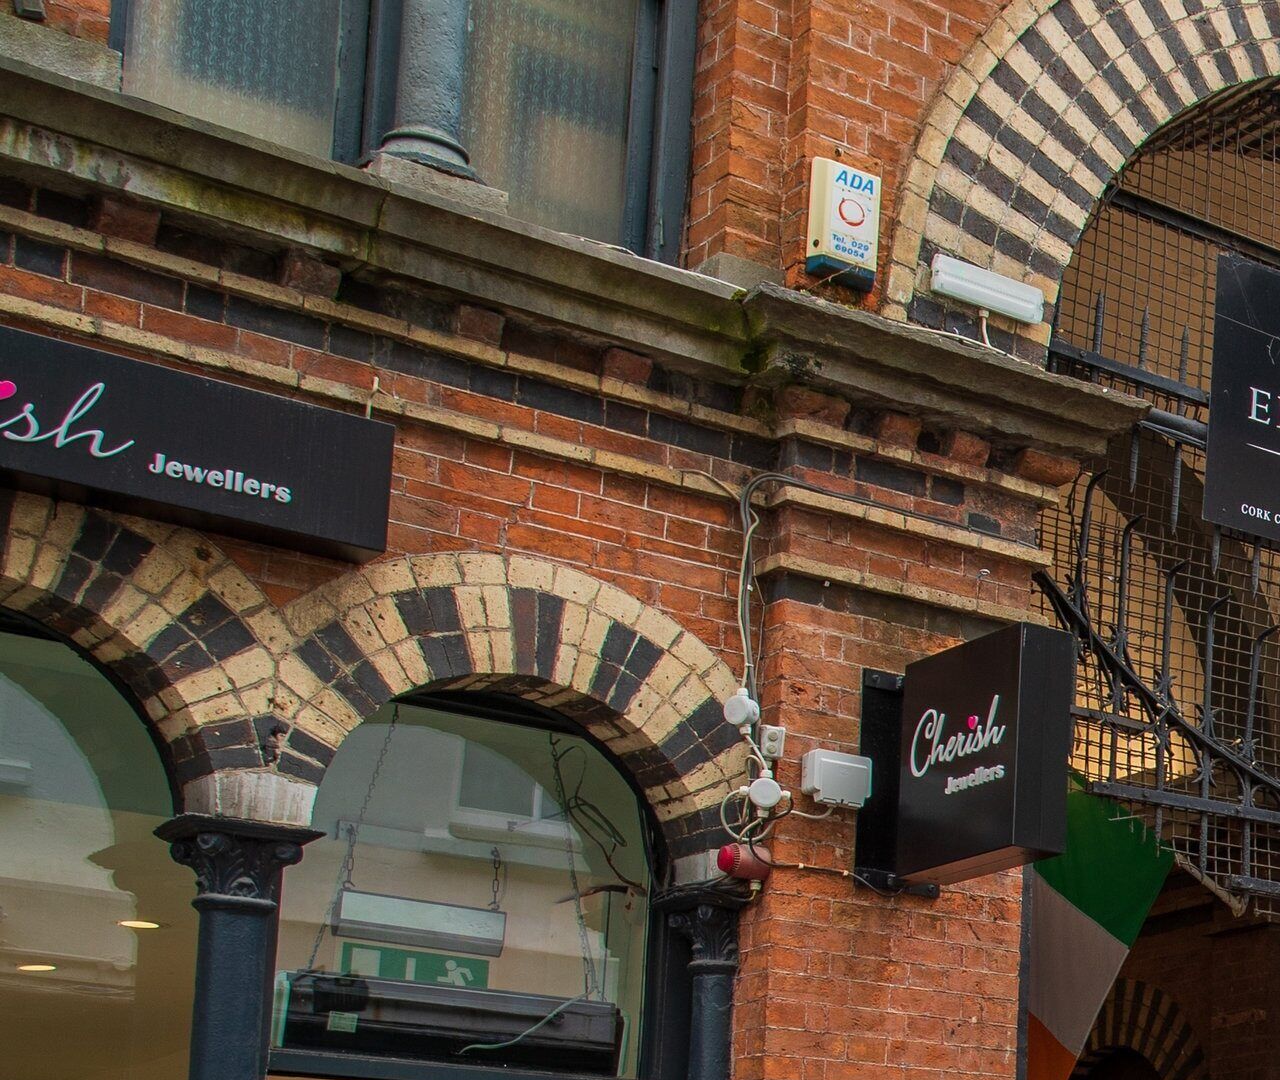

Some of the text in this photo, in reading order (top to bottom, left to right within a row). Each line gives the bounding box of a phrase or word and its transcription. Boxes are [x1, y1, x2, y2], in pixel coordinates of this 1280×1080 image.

[835, 169, 874, 195] ADA
[832, 233, 869, 252] Tel. 029
[834, 243, 865, 259] 69054
[0, 380, 293, 504] sh Jewellers
[1240, 503, 1272, 521] CORK
[909, 693, 1006, 778] Cherish
[944, 764, 1006, 796] Jewellers
